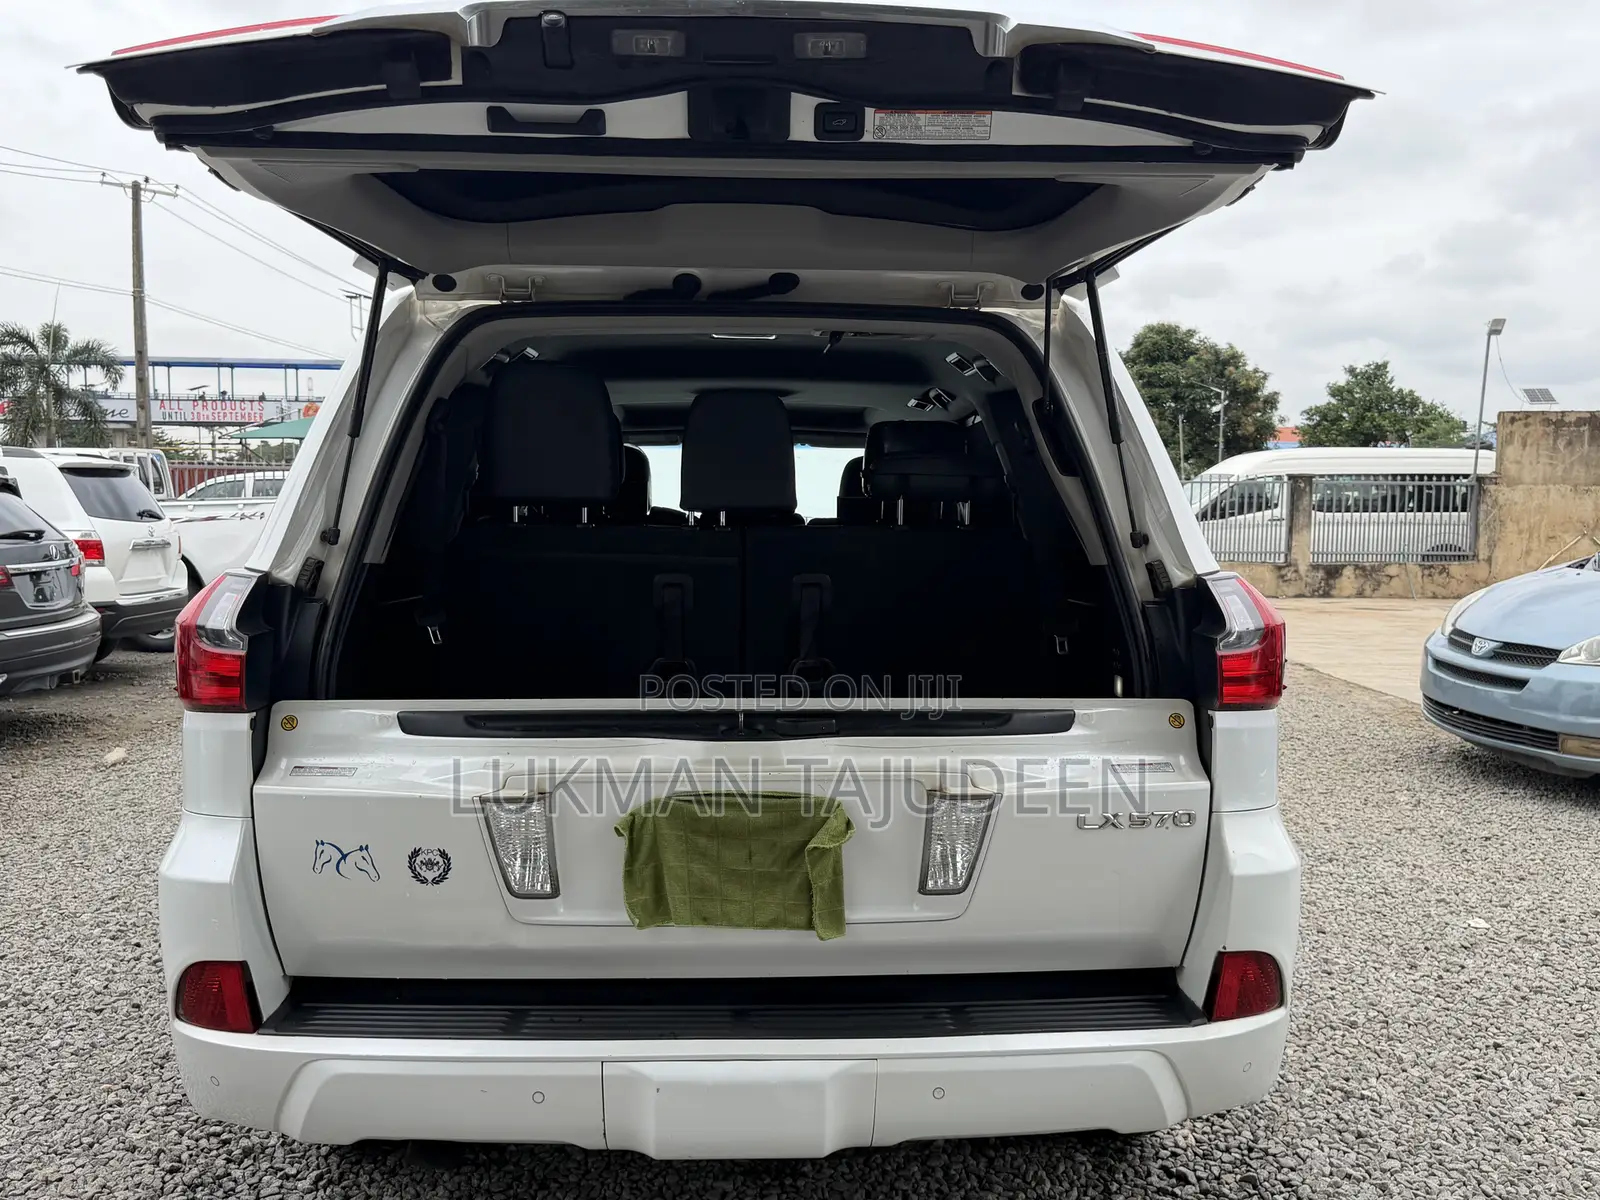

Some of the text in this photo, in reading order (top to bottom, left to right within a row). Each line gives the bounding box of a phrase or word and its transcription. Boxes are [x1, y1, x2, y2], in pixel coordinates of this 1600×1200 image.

[159, 400, 265, 411] ALL PRODUCTS
[162, 411, 187, 421] UNTIL
[211, 412, 264, 421] SEPTEMBER
[1076, 809, 1197, 829] LX 570
